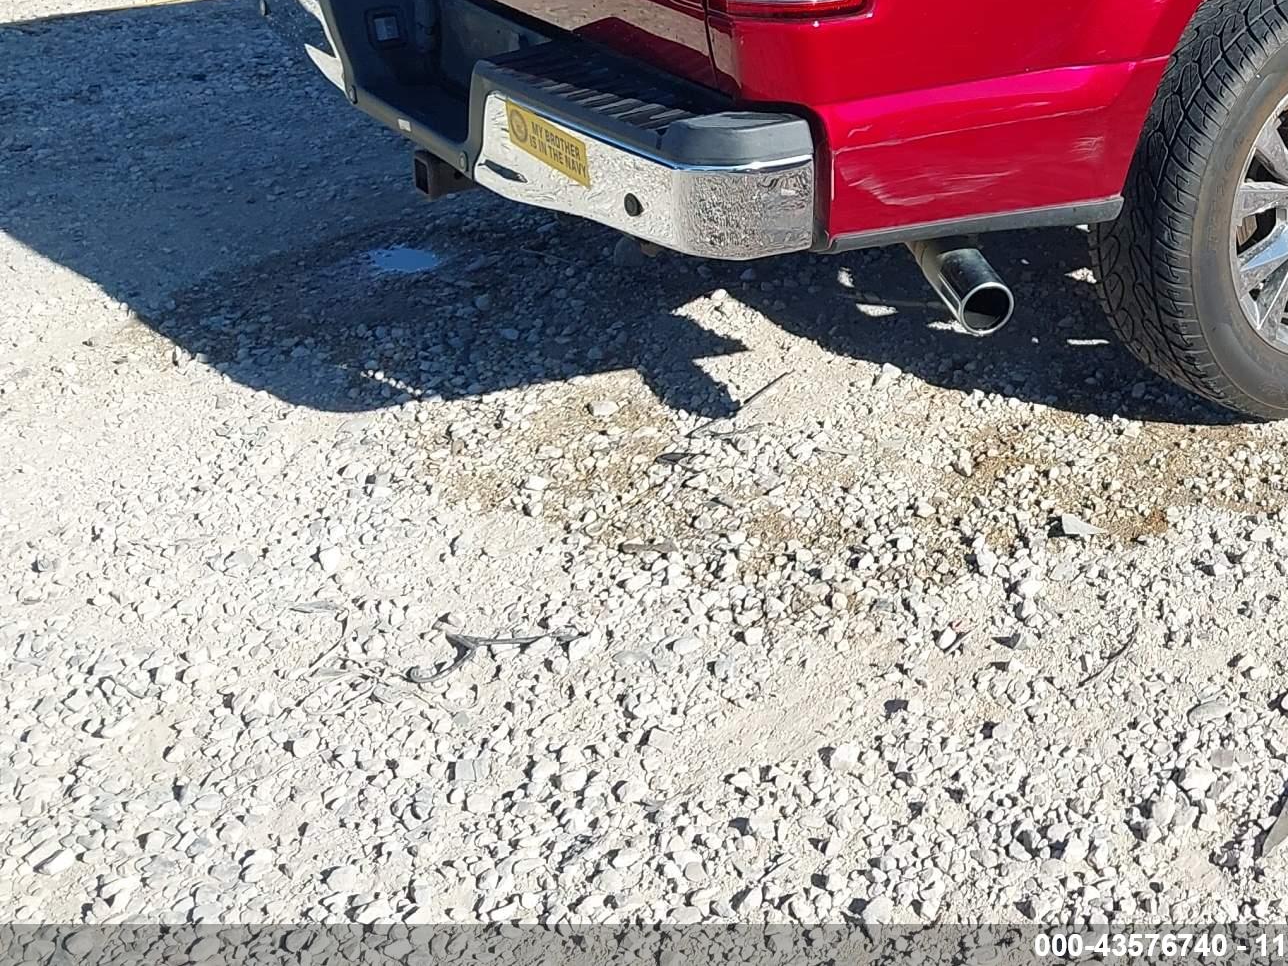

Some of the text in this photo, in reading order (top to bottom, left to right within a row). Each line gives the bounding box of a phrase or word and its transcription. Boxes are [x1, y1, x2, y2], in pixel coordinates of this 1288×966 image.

[529, 134, 586, 178] IS IN THE NAVY
[531, 121, 581, 161] MY BROTHER
